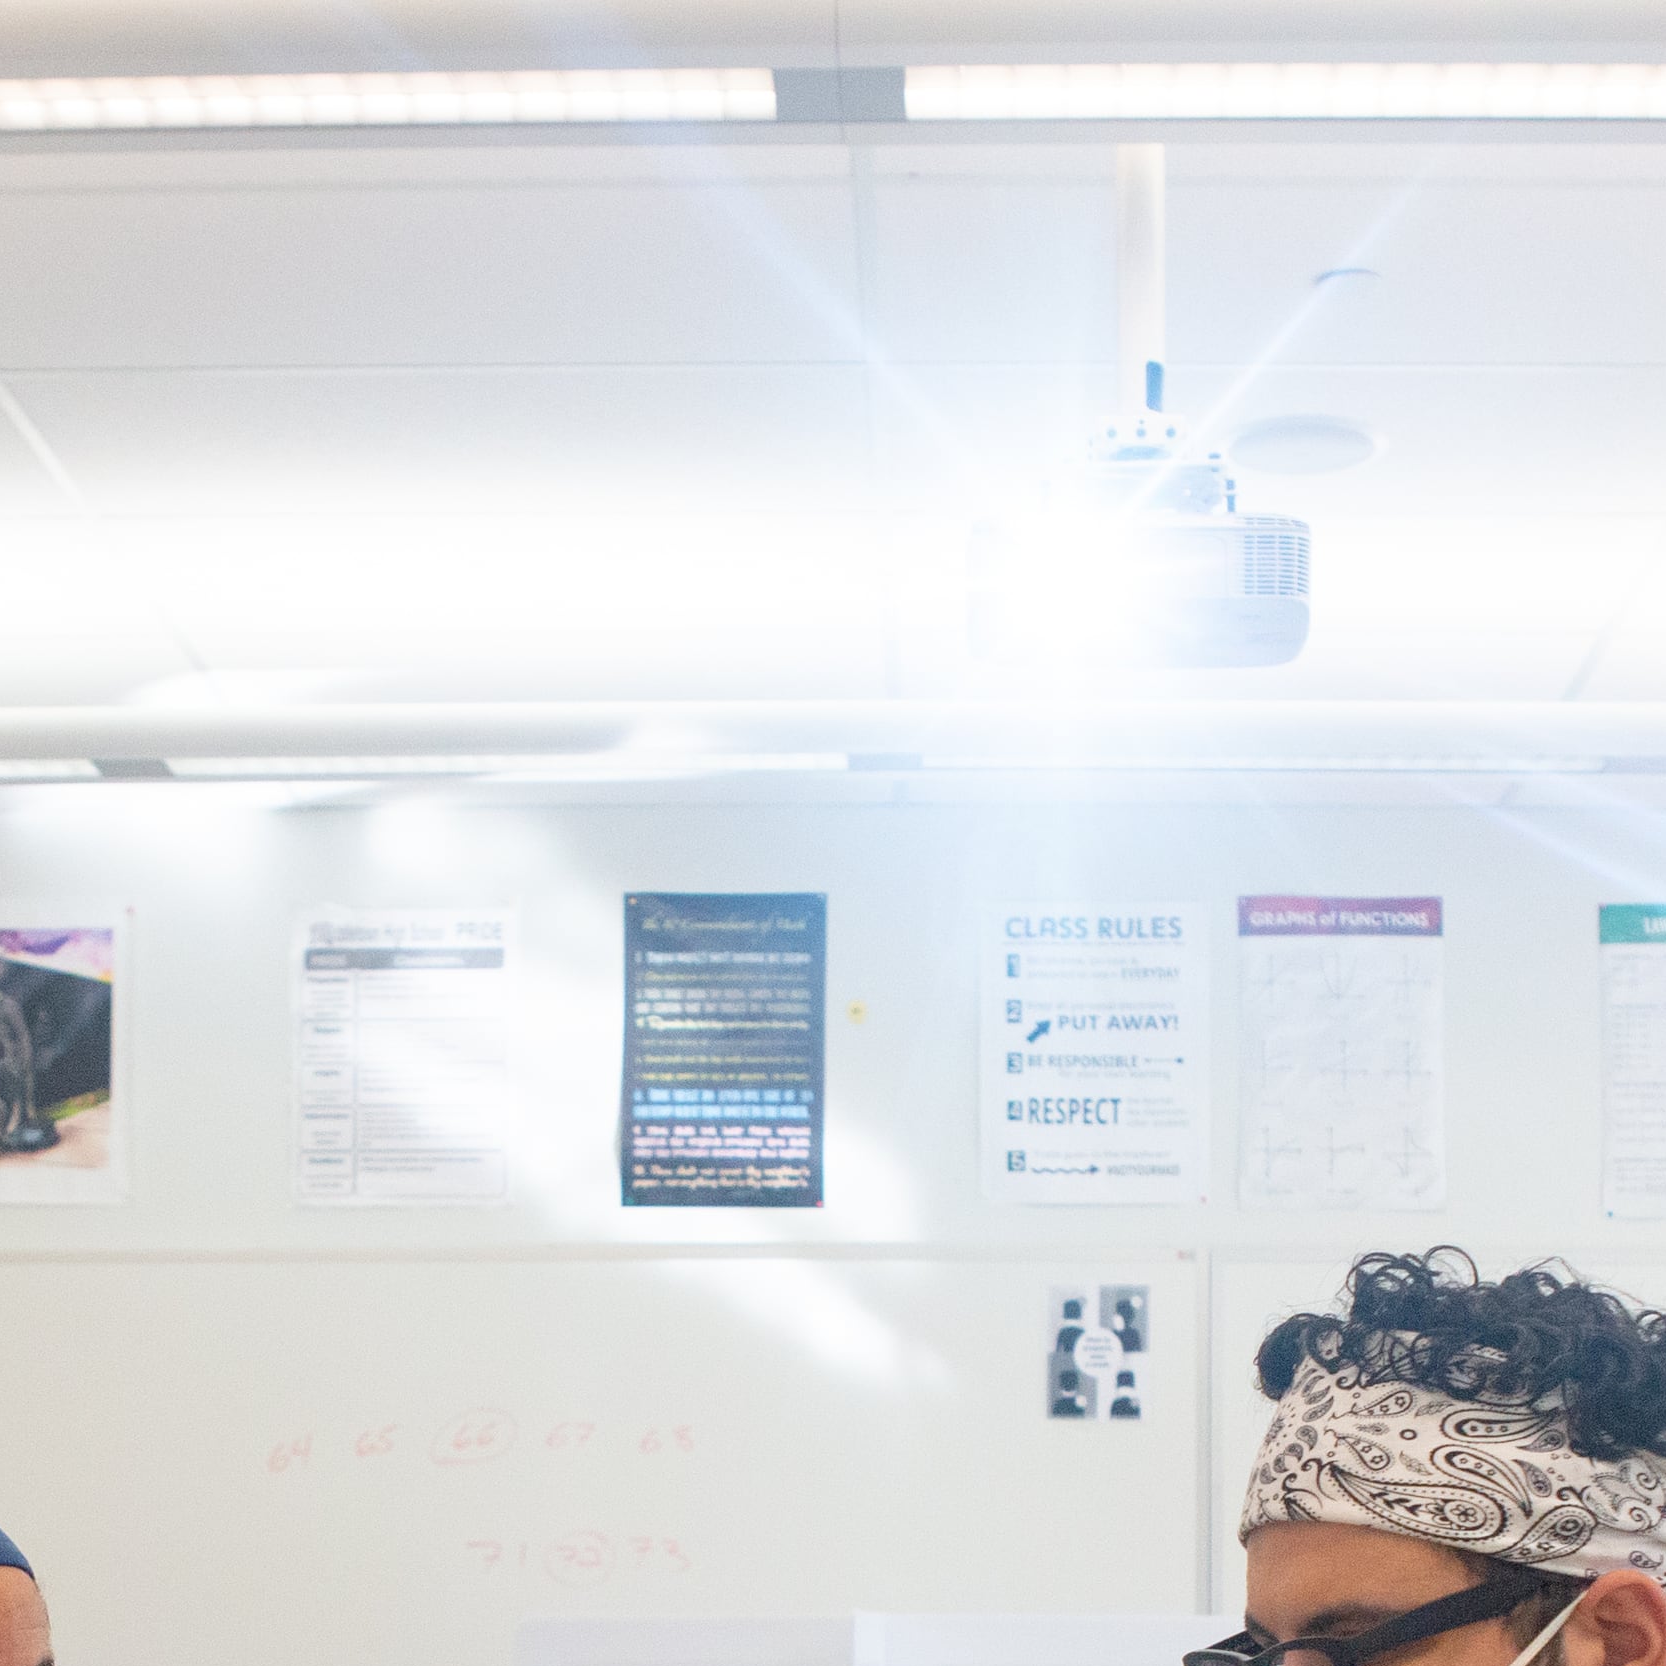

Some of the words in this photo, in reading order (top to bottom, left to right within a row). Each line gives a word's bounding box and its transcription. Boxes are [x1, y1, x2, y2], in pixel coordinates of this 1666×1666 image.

[1005, 916, 1088, 939] CLASS
[1098, 916, 1182, 939] RULES
[1249, 911, 1316, 927] GRAPHS
[1319, 911, 1336, 926] of
[1339, 911, 1429, 928] FUNCTIONS
[1120, 967, 1180, 980] EVERYDAY
[1057, 1015, 1100, 1031] PUT
[1107, 1015, 1179, 1031] AWAY!
[1027, 1054, 1044, 1068] BE
[1048, 1054, 1139, 1068] RESPONSIBLE
[1027, 1097, 1121, 1126] RESPECT
[266, 1431, 314, 1474] 64
[355, 1421, 400, 1459] 65
[451, 1420, 497, 1451] 66
[544, 1420, 597, 1451] 67
[465, 1538, 528, 1574] 71
